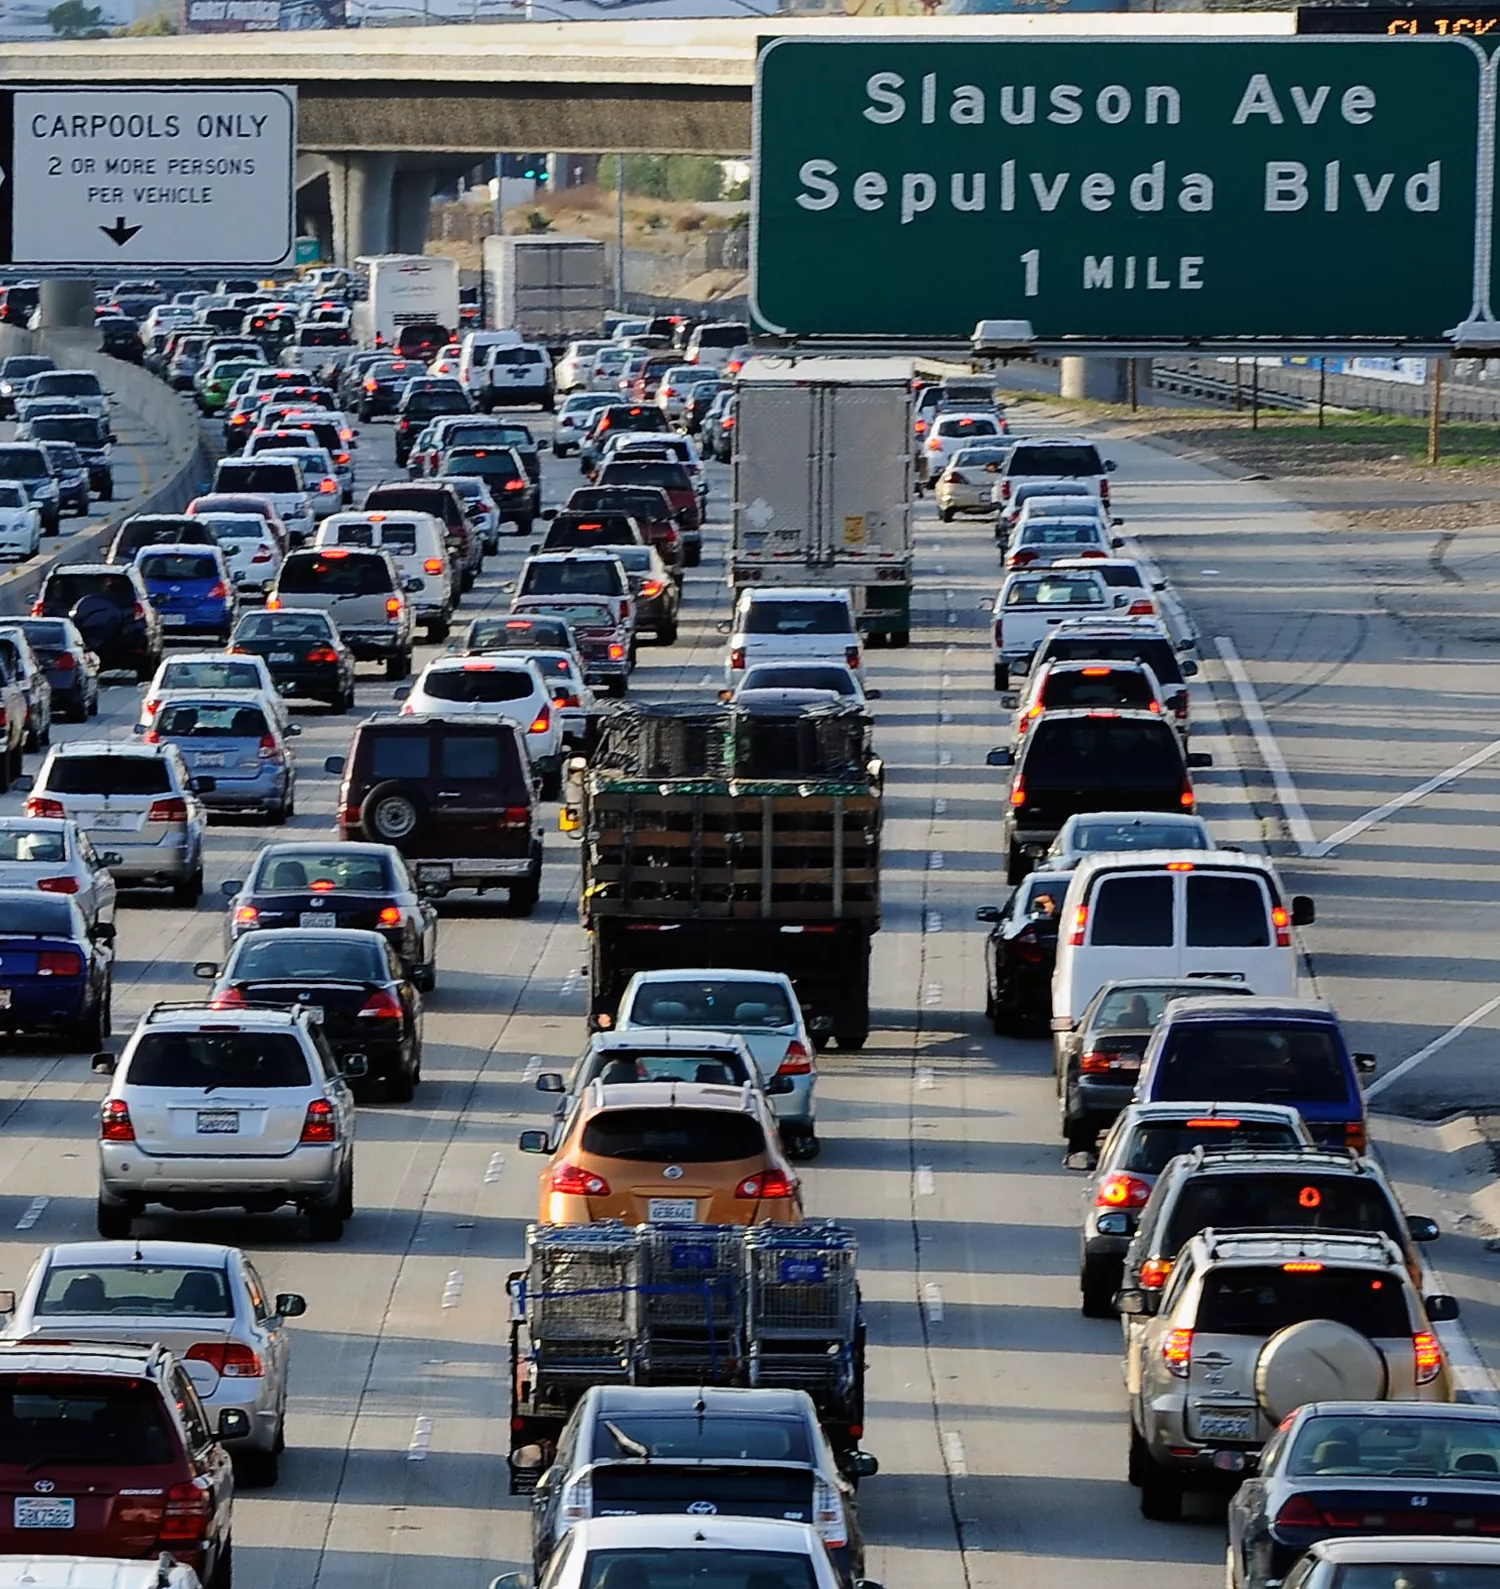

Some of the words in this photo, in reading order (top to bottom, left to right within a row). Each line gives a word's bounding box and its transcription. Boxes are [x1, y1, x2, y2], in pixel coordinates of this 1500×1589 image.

[863, 72, 1180, 125] Slauson
[1232, 74, 1376, 125] Ave
[31, 114, 181, 138] CARPOOLS
[197, 114, 269, 138] ONLY
[48, 156, 62, 176] 2
[71, 157, 96, 175] OR
[105, 158, 157, 175] MORE
[167, 158, 255, 176] PERSONS
[87, 187, 124, 204] PER
[133, 186, 213, 204] VEHICLE
[796, 159, 1214, 224] Sepulveda
[1265, 160, 1440, 212] Blvd
[1020, 249, 1040, 296] 1
[1084, 255, 1204, 289] MILE
